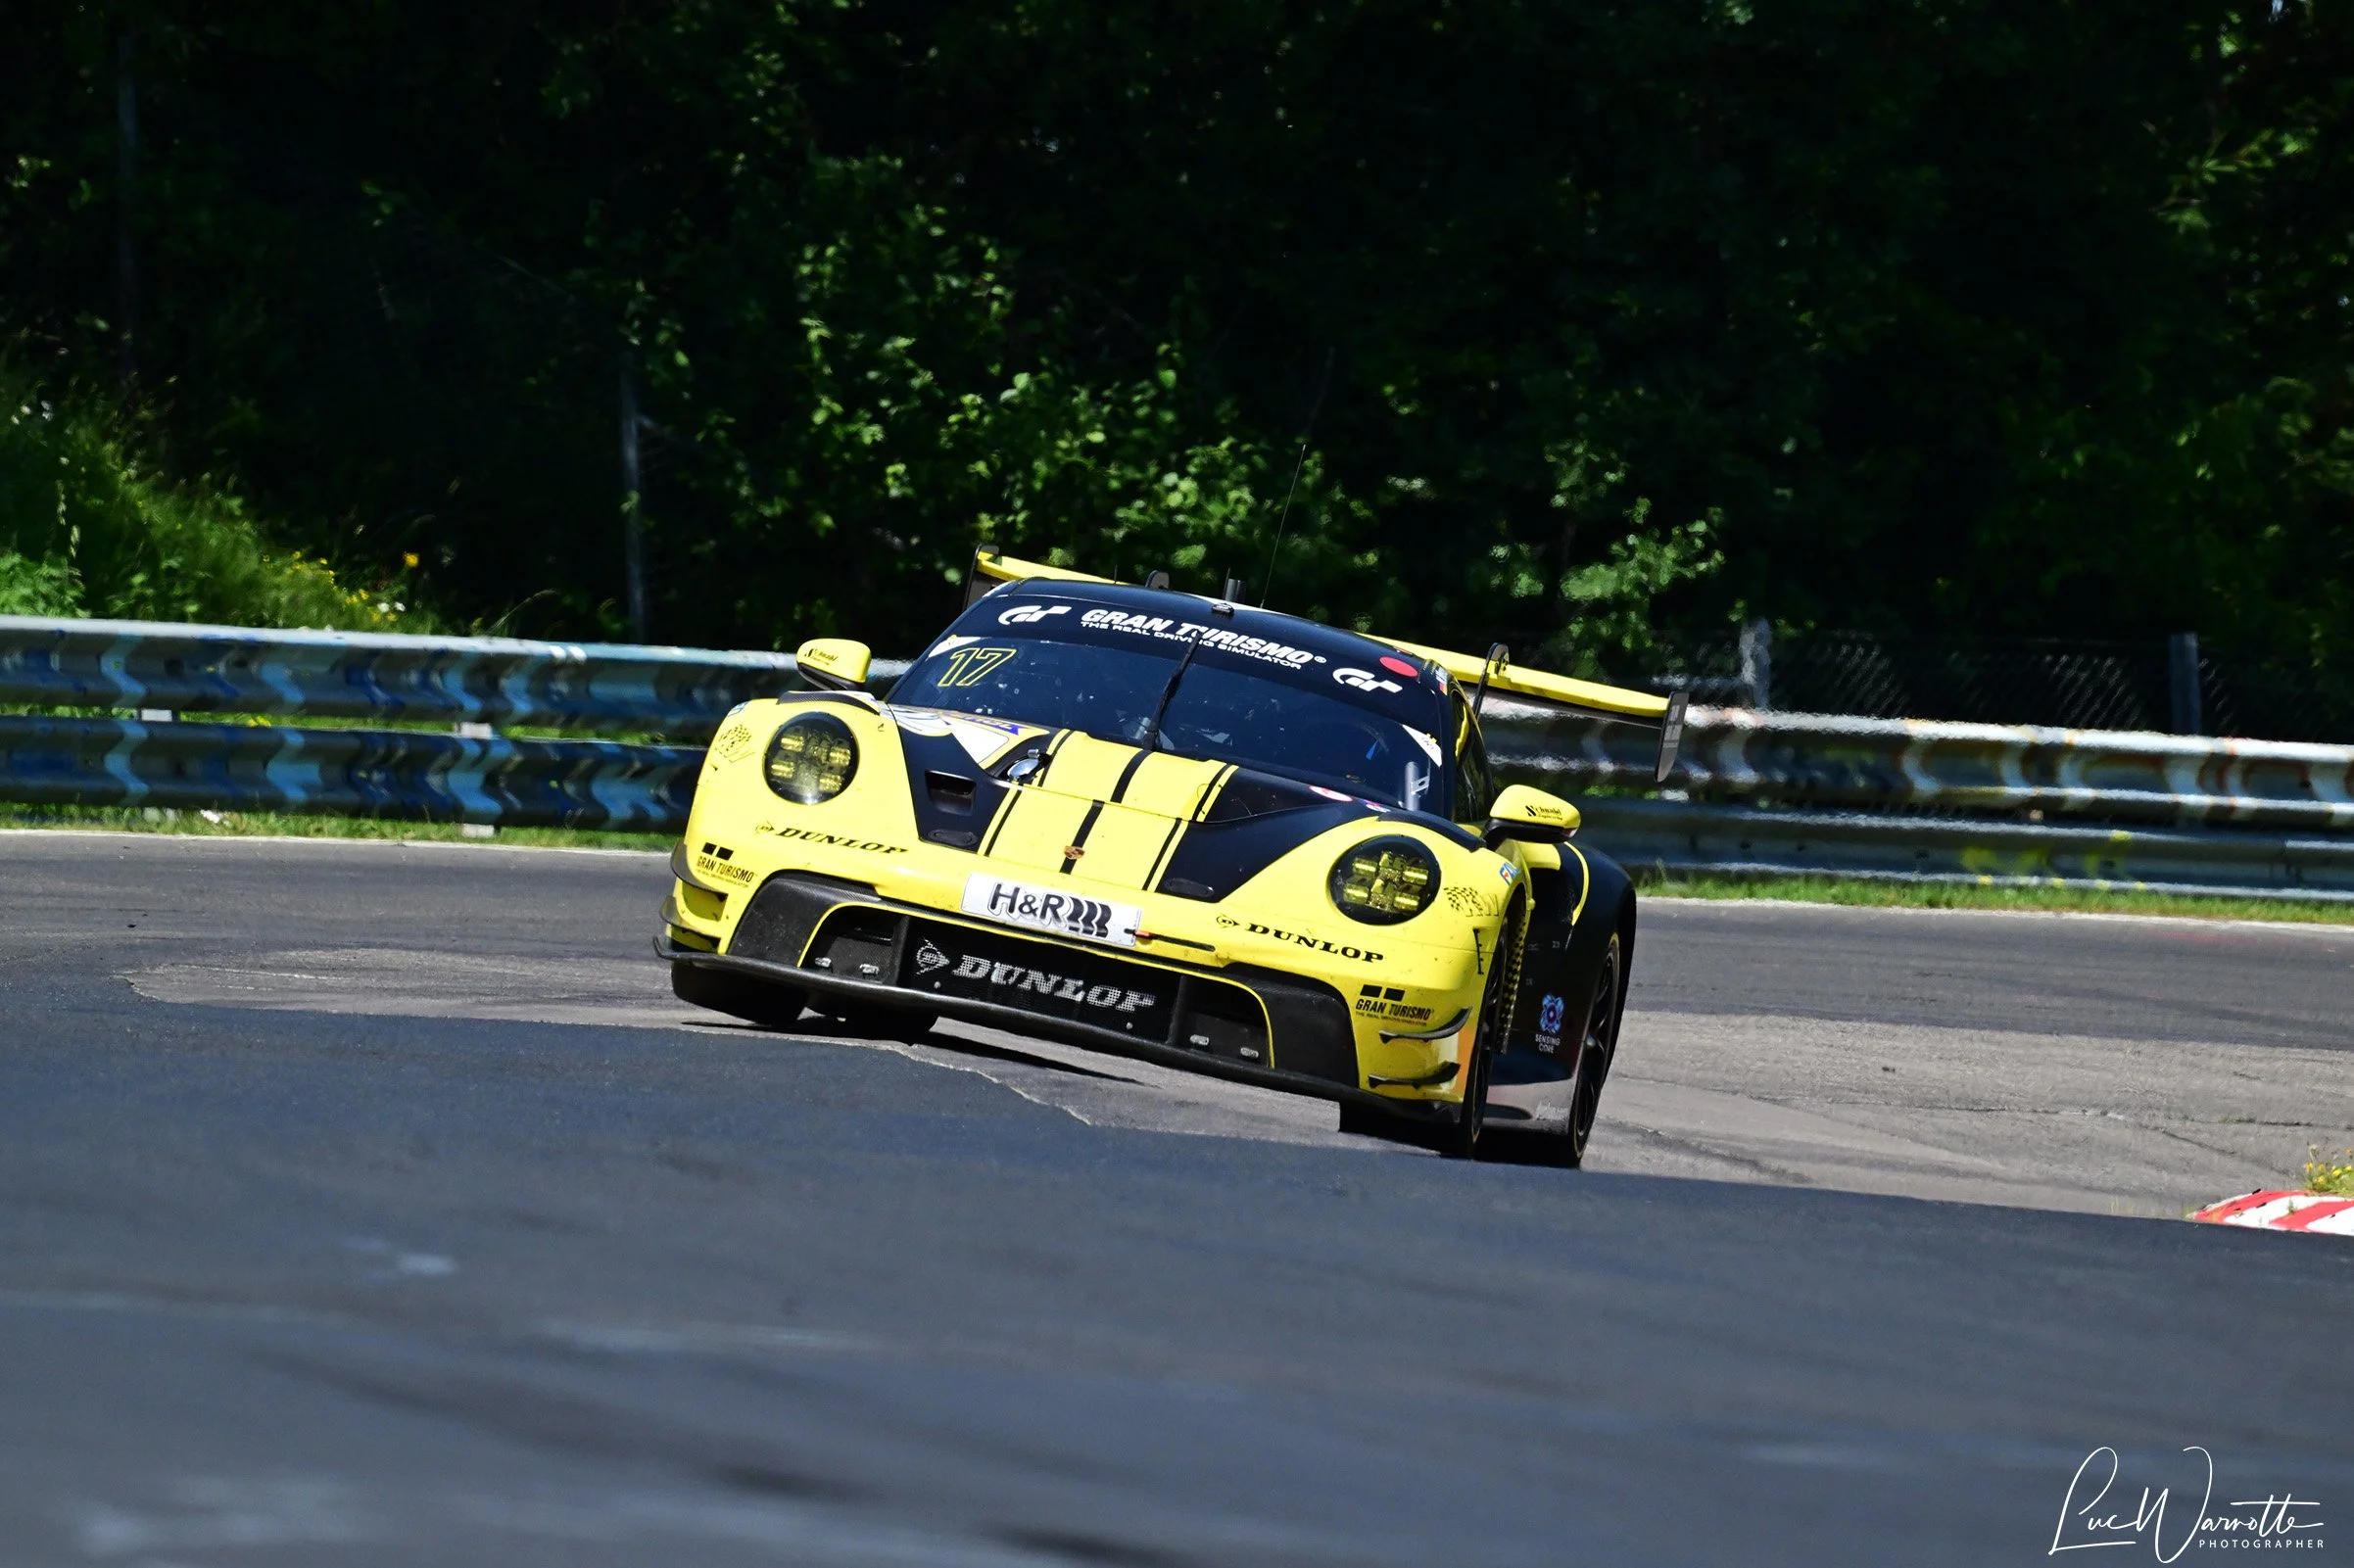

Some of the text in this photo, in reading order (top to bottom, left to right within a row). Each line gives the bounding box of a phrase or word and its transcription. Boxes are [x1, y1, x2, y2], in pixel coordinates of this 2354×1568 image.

[1081, 609, 1316, 665] GRAN TURISMO
[1081, 621, 1109, 630] THE
[1112, 624, 1151, 636] REAL
[1217, 642, 1302, 670] SIMULATOR
[937, 647, 1018, 688] 17
[775, 827, 909, 855] DUNLOP
[696, 855, 718, 873] GRAN
[716, 860, 755, 883] TURISMO
[988, 883, 1067, 923] H&R
[1244, 922, 1384, 964] DUNLOP
[951, 954, 1158, 1013] DUNLOP
[1355, 998, 1432, 1022] GRAN TURISMO
[1535, 1033, 1561, 1047] SENSING
